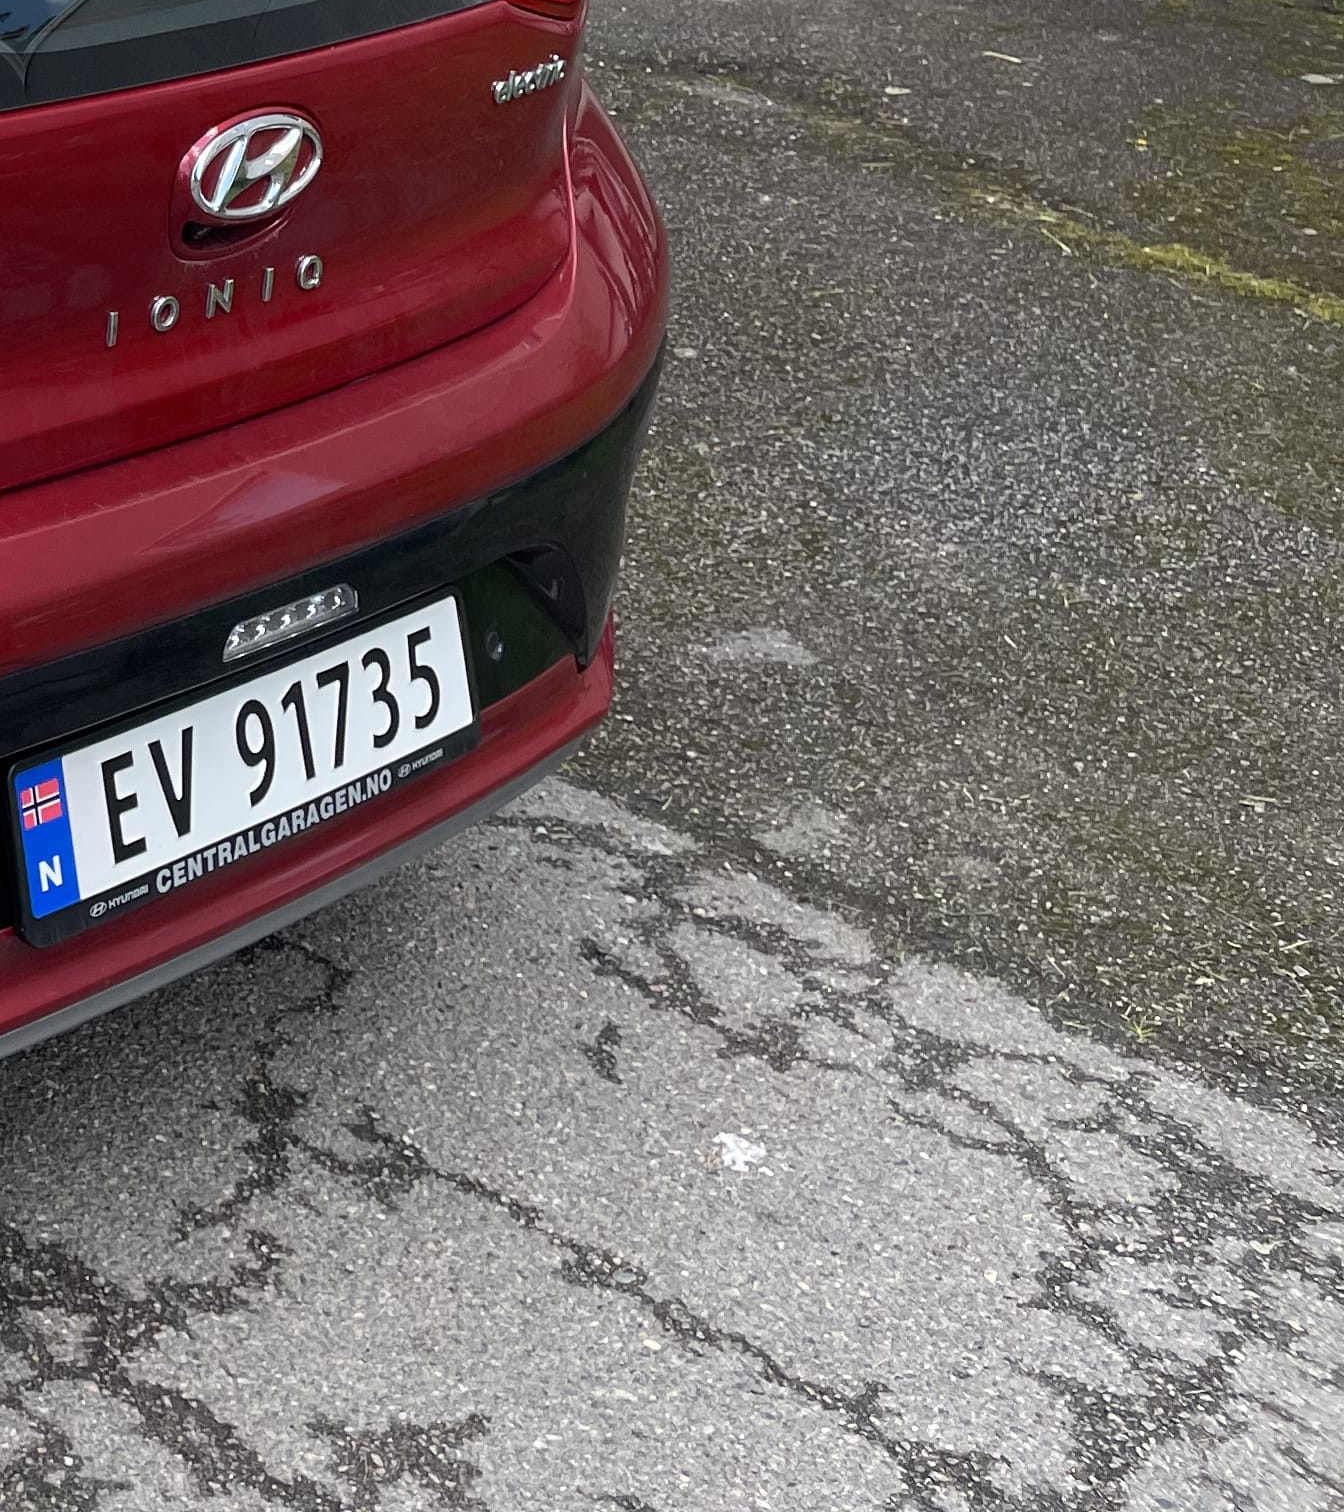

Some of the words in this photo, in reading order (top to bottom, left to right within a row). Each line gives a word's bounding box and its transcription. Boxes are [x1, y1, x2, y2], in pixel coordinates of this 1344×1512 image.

[106, 254, 323, 347] IONIQ
[100, 725, 194, 865] EV
[235, 625, 441, 808] 91735
[38, 855, 63, 892] N
[108, 884, 149, 909] HYUNDAI
[155, 768, 392, 893] CENTRALGARAGEN.NO
